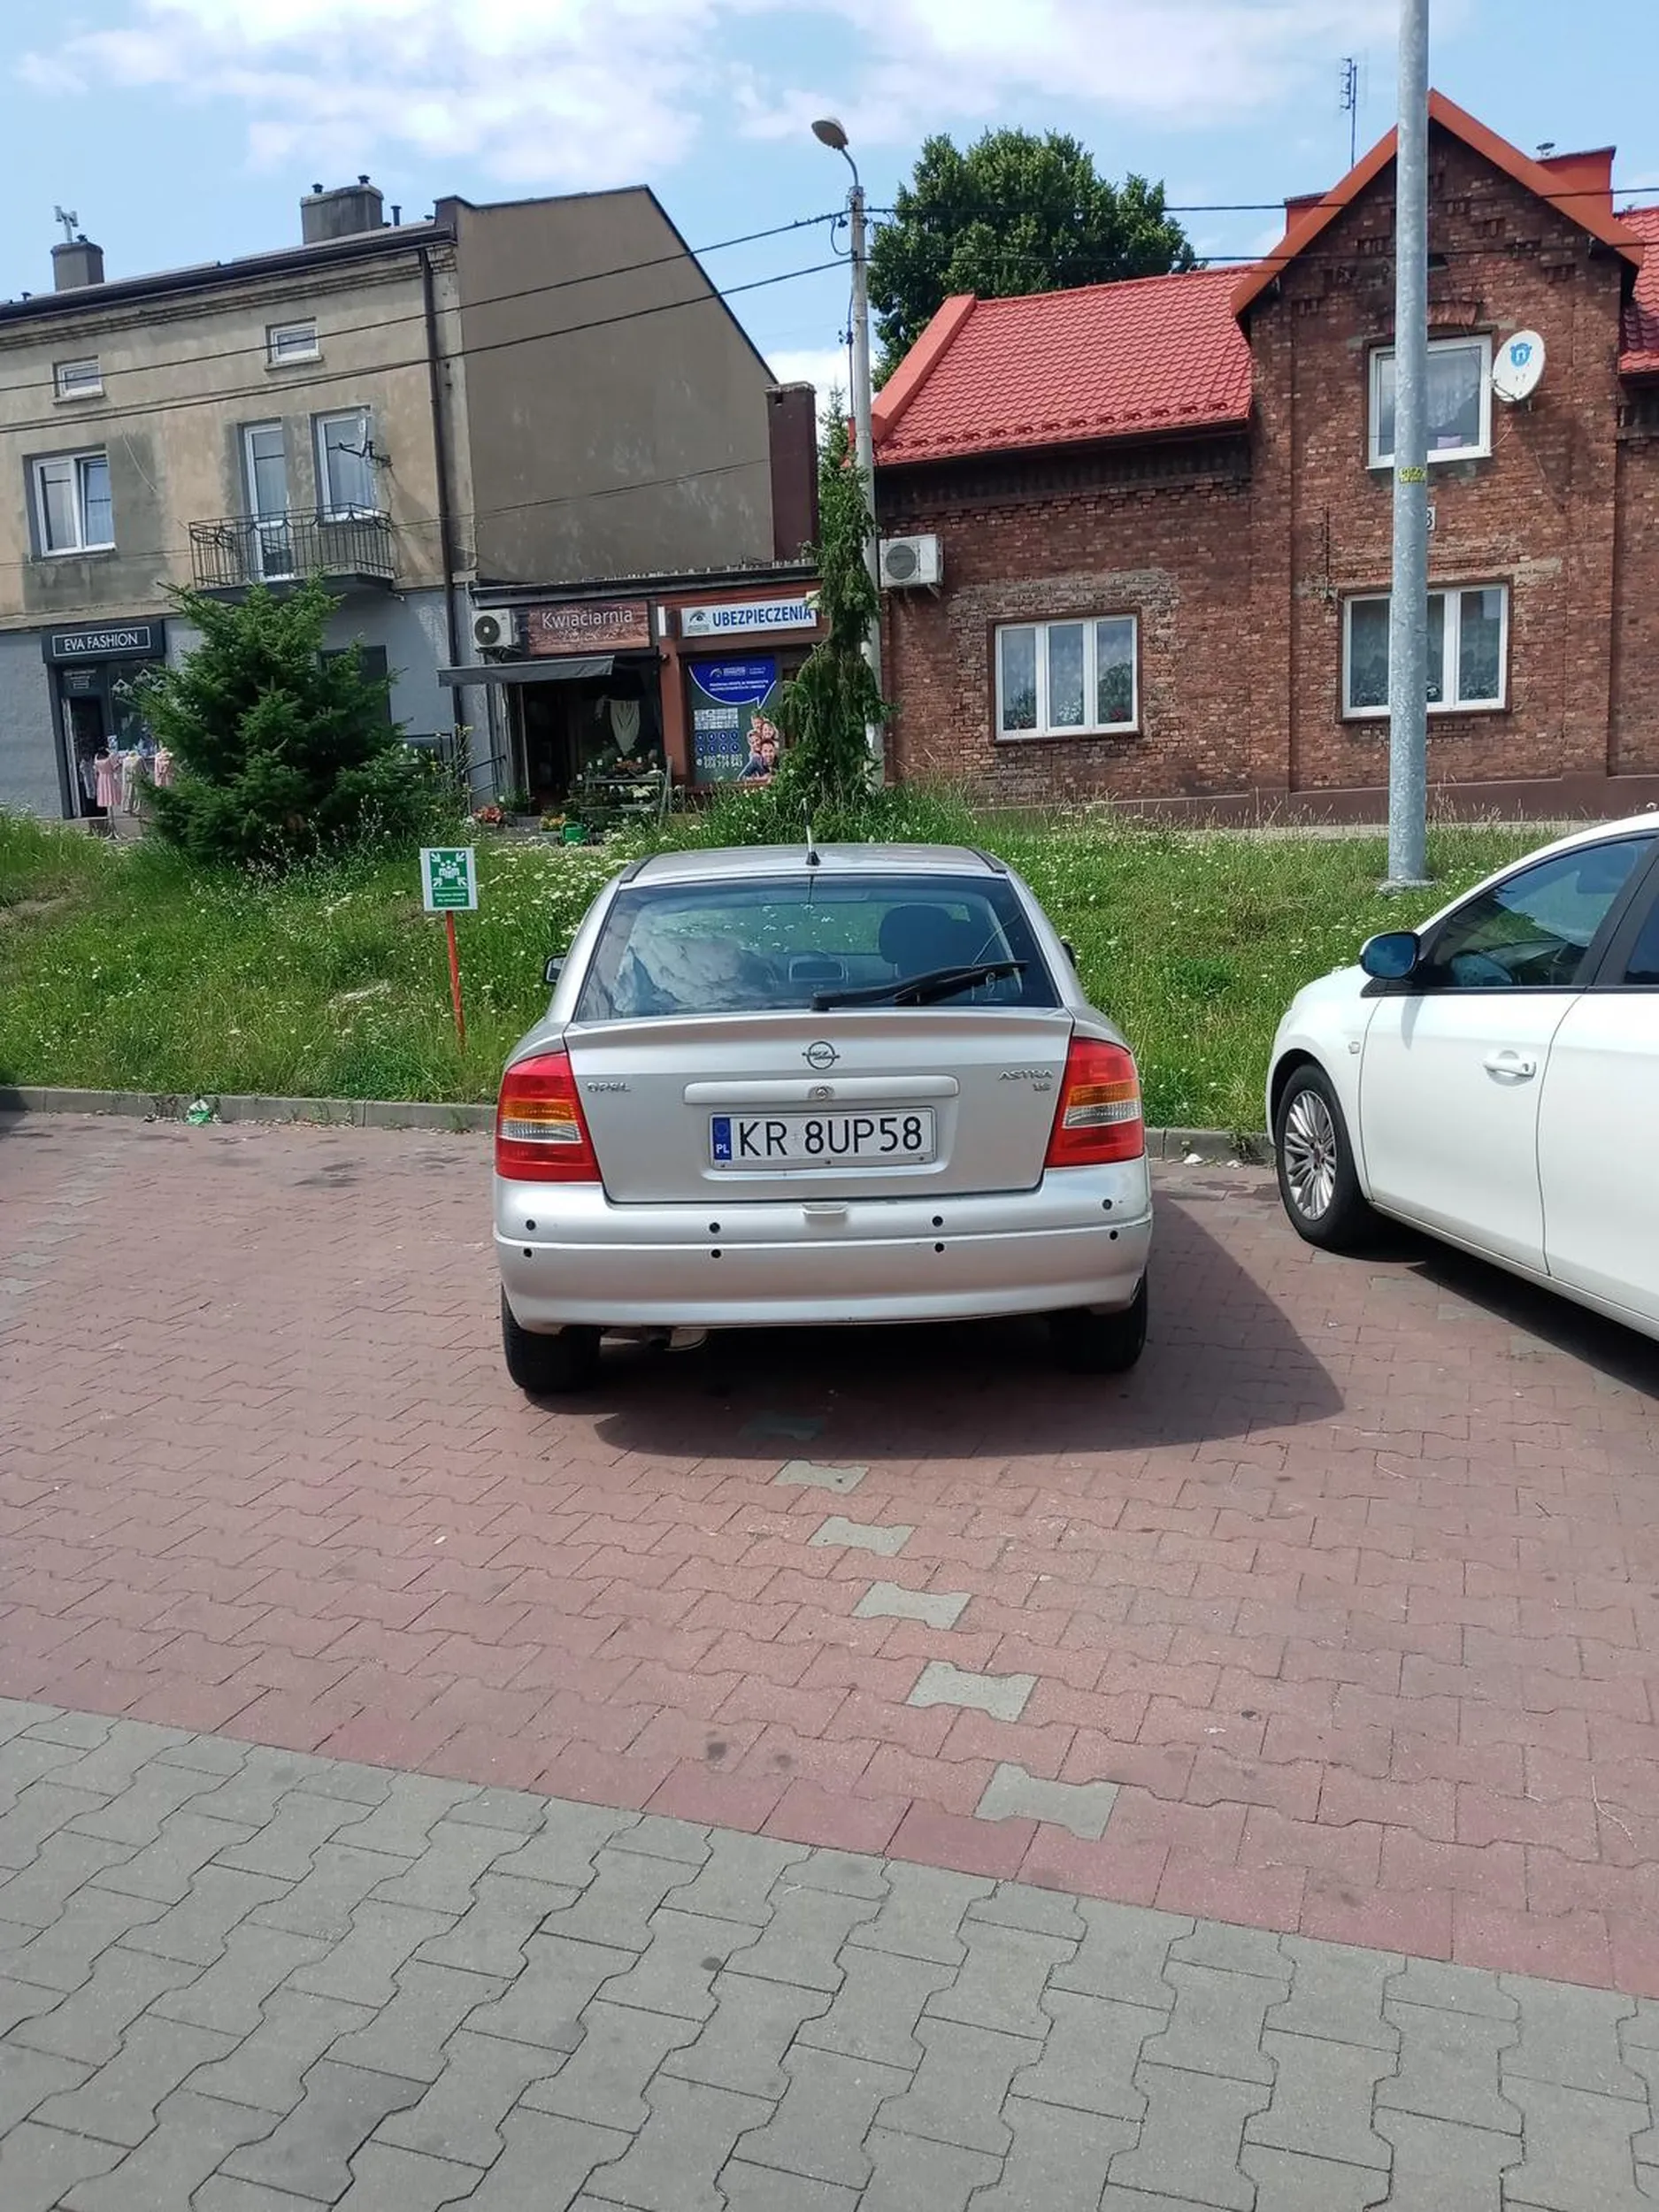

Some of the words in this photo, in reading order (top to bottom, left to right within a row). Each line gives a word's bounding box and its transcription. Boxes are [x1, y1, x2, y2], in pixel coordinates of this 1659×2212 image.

[541, 605, 634, 629] Kwiaciarnia
[712, 605, 812, 627] UBEZPIECZENIA
[64, 639, 86, 652] EVA
[87, 632, 139, 649] FASHION
[997, 1068, 1054, 1081] ASTRA
[587, 1081, 632, 1093] OPEL
[739, 1121, 787, 1156] KR
[804, 1116, 923, 1154] 8UP58
[716, 1144, 729, 1154] PL
